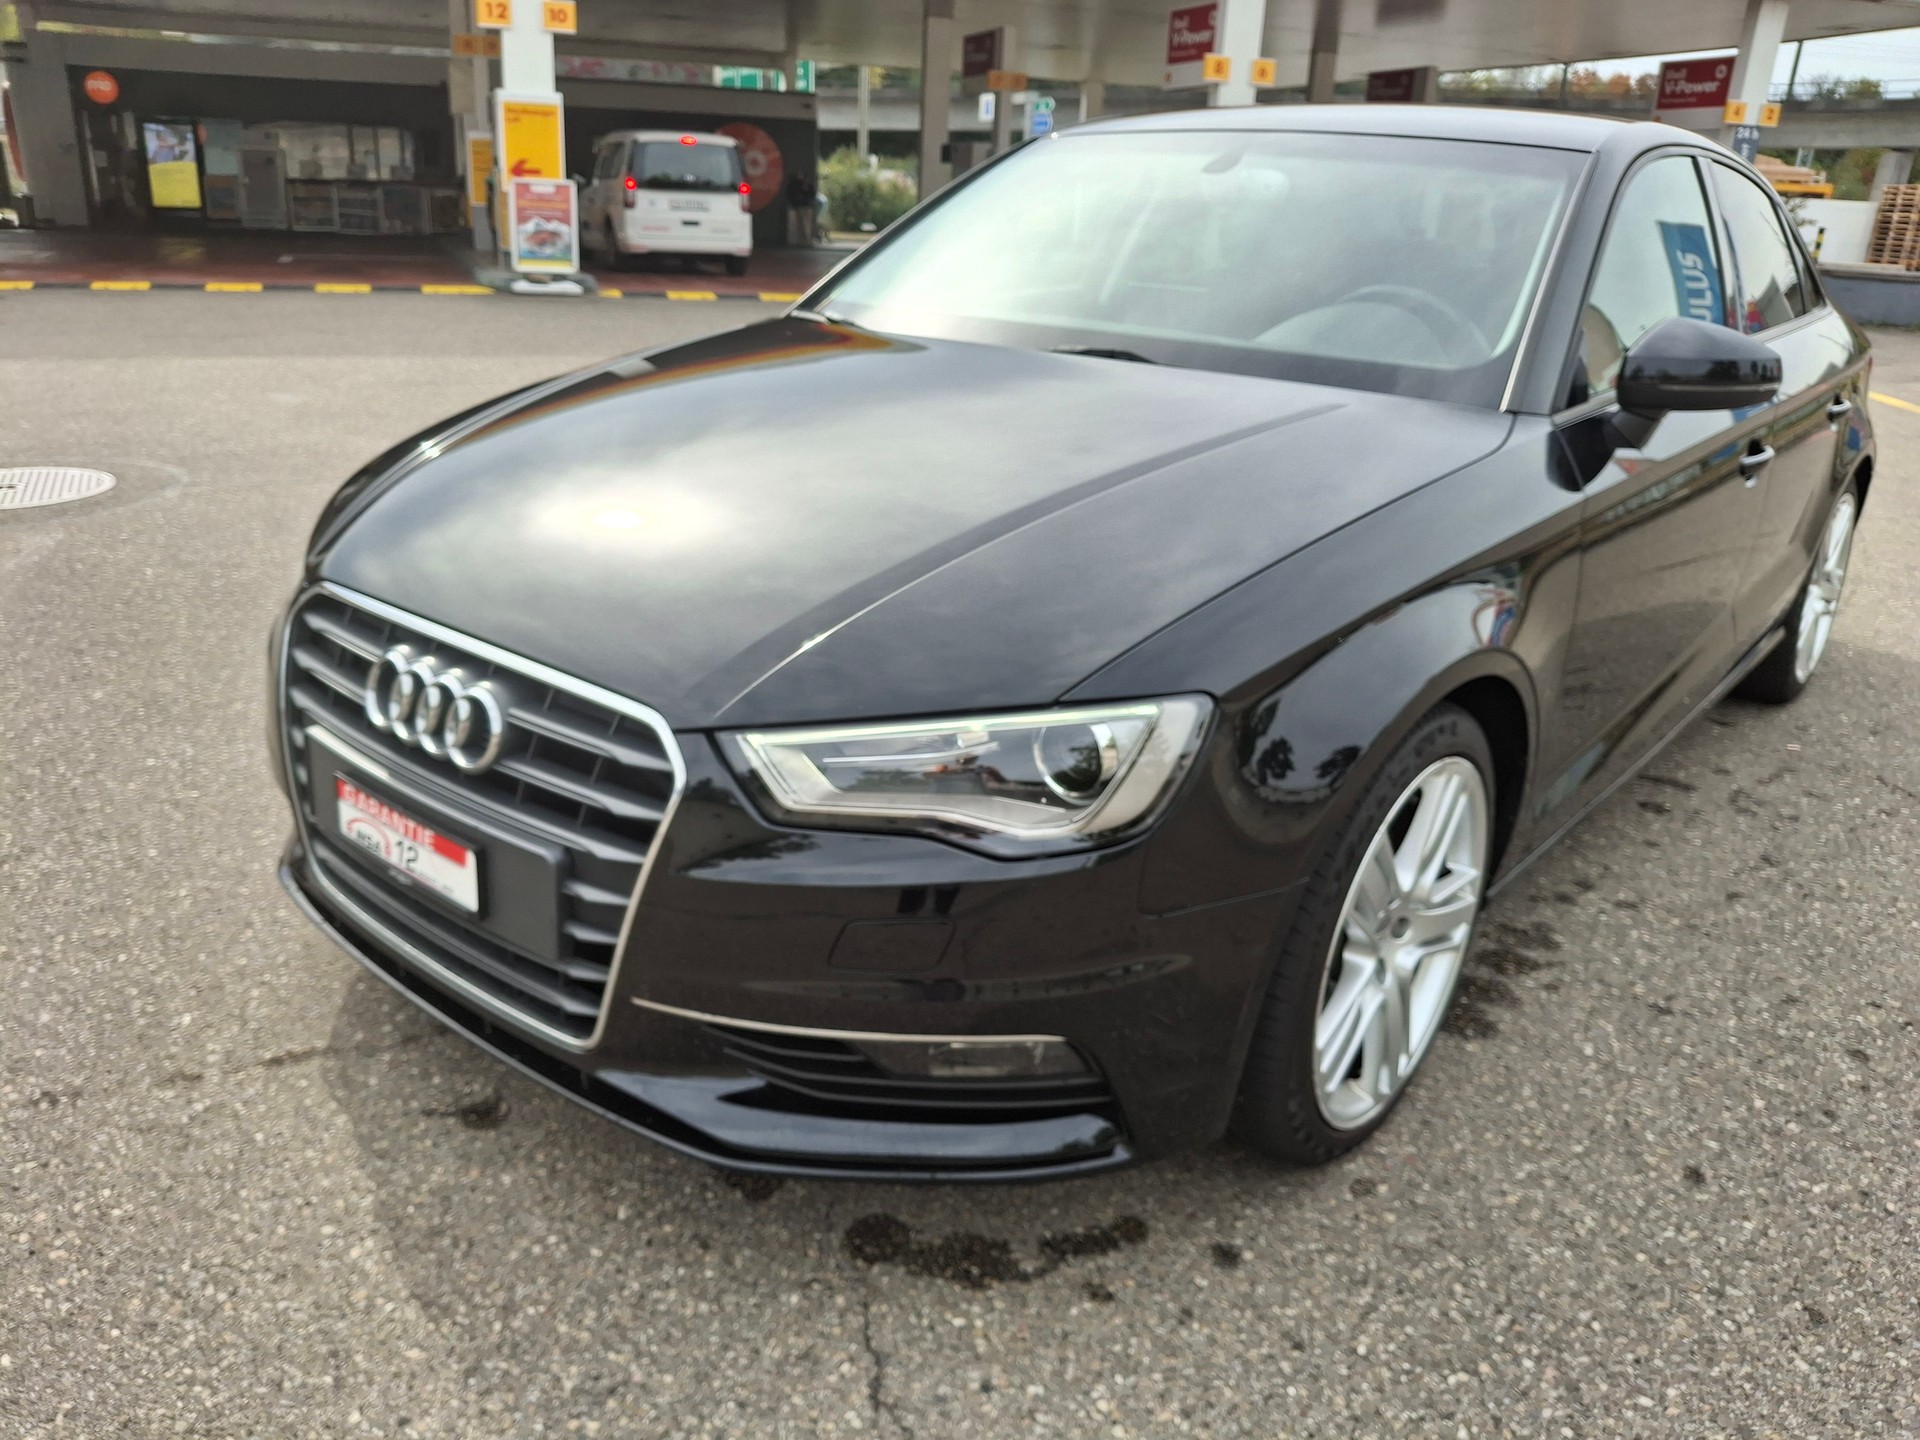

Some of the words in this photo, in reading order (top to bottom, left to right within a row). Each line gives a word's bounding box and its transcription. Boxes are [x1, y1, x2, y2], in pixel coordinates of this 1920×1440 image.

[485, 2, 507, 19] 12
[549, 8, 568, 23] 10
[1664, 80, 1721, 95] V-Power
[342, 782, 435, 847] GARANTIE
[396, 840, 419, 871] 12
